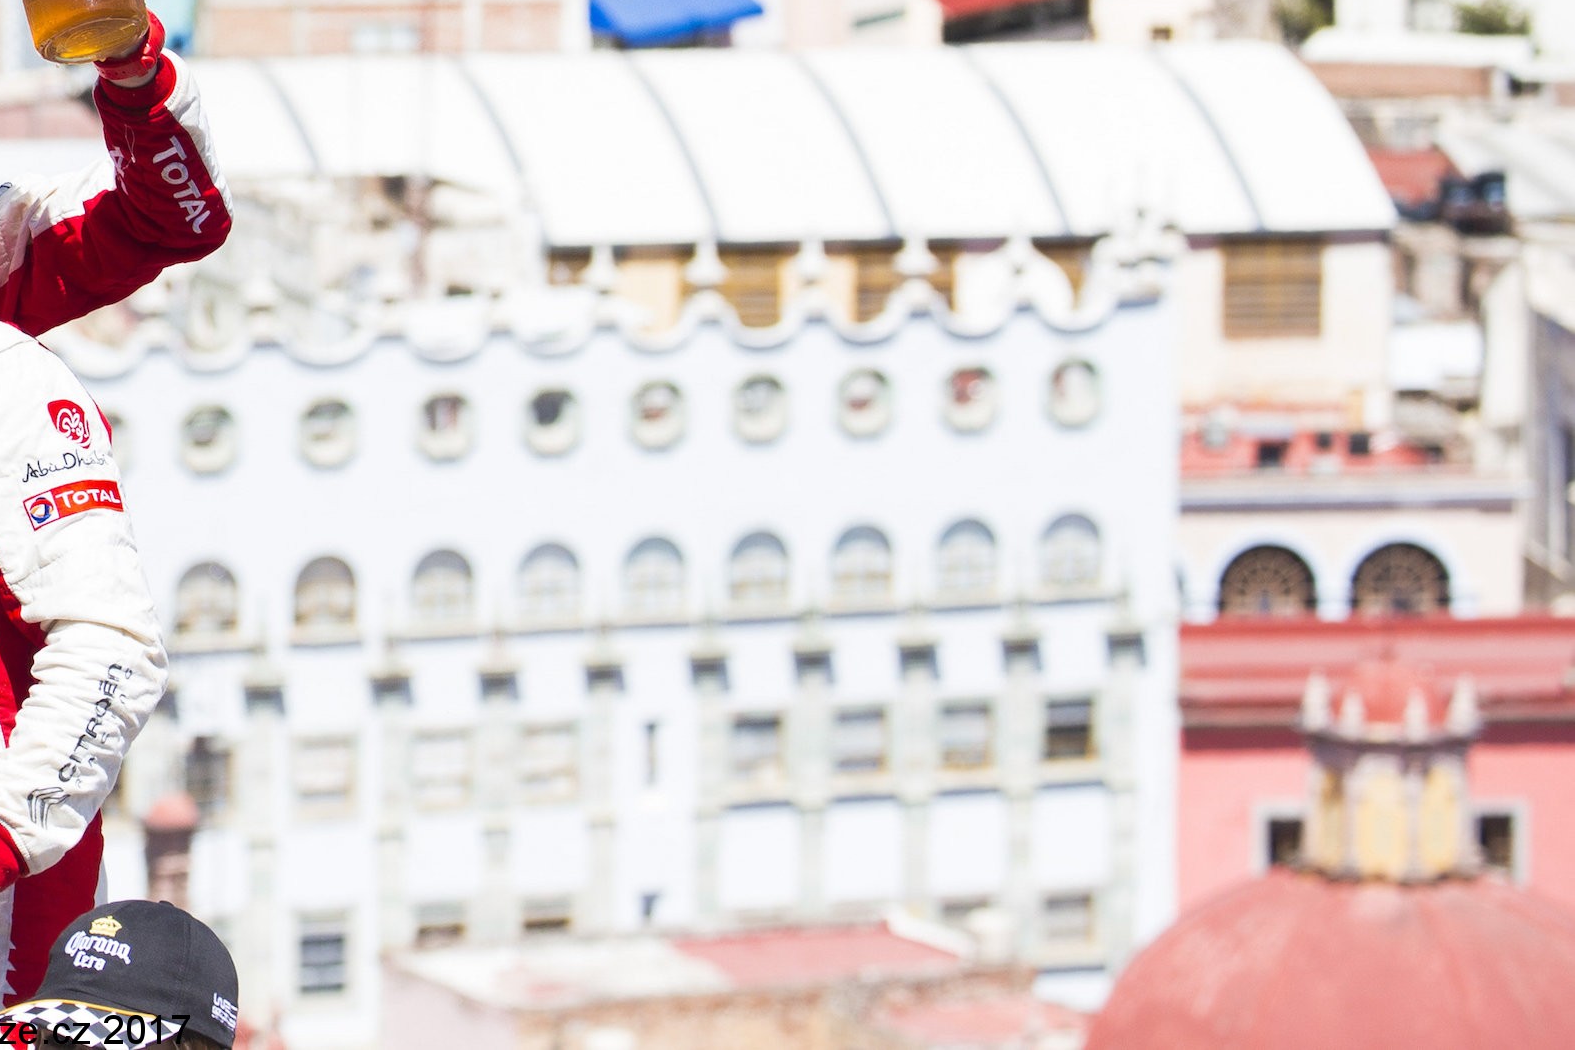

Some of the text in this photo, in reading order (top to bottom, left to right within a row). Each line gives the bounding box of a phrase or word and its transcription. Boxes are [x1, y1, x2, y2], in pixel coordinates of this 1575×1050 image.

[152, 135, 212, 234] TOTAL
[55, 488, 121, 508] TOTAL
[65, 931, 131, 965] Corona
